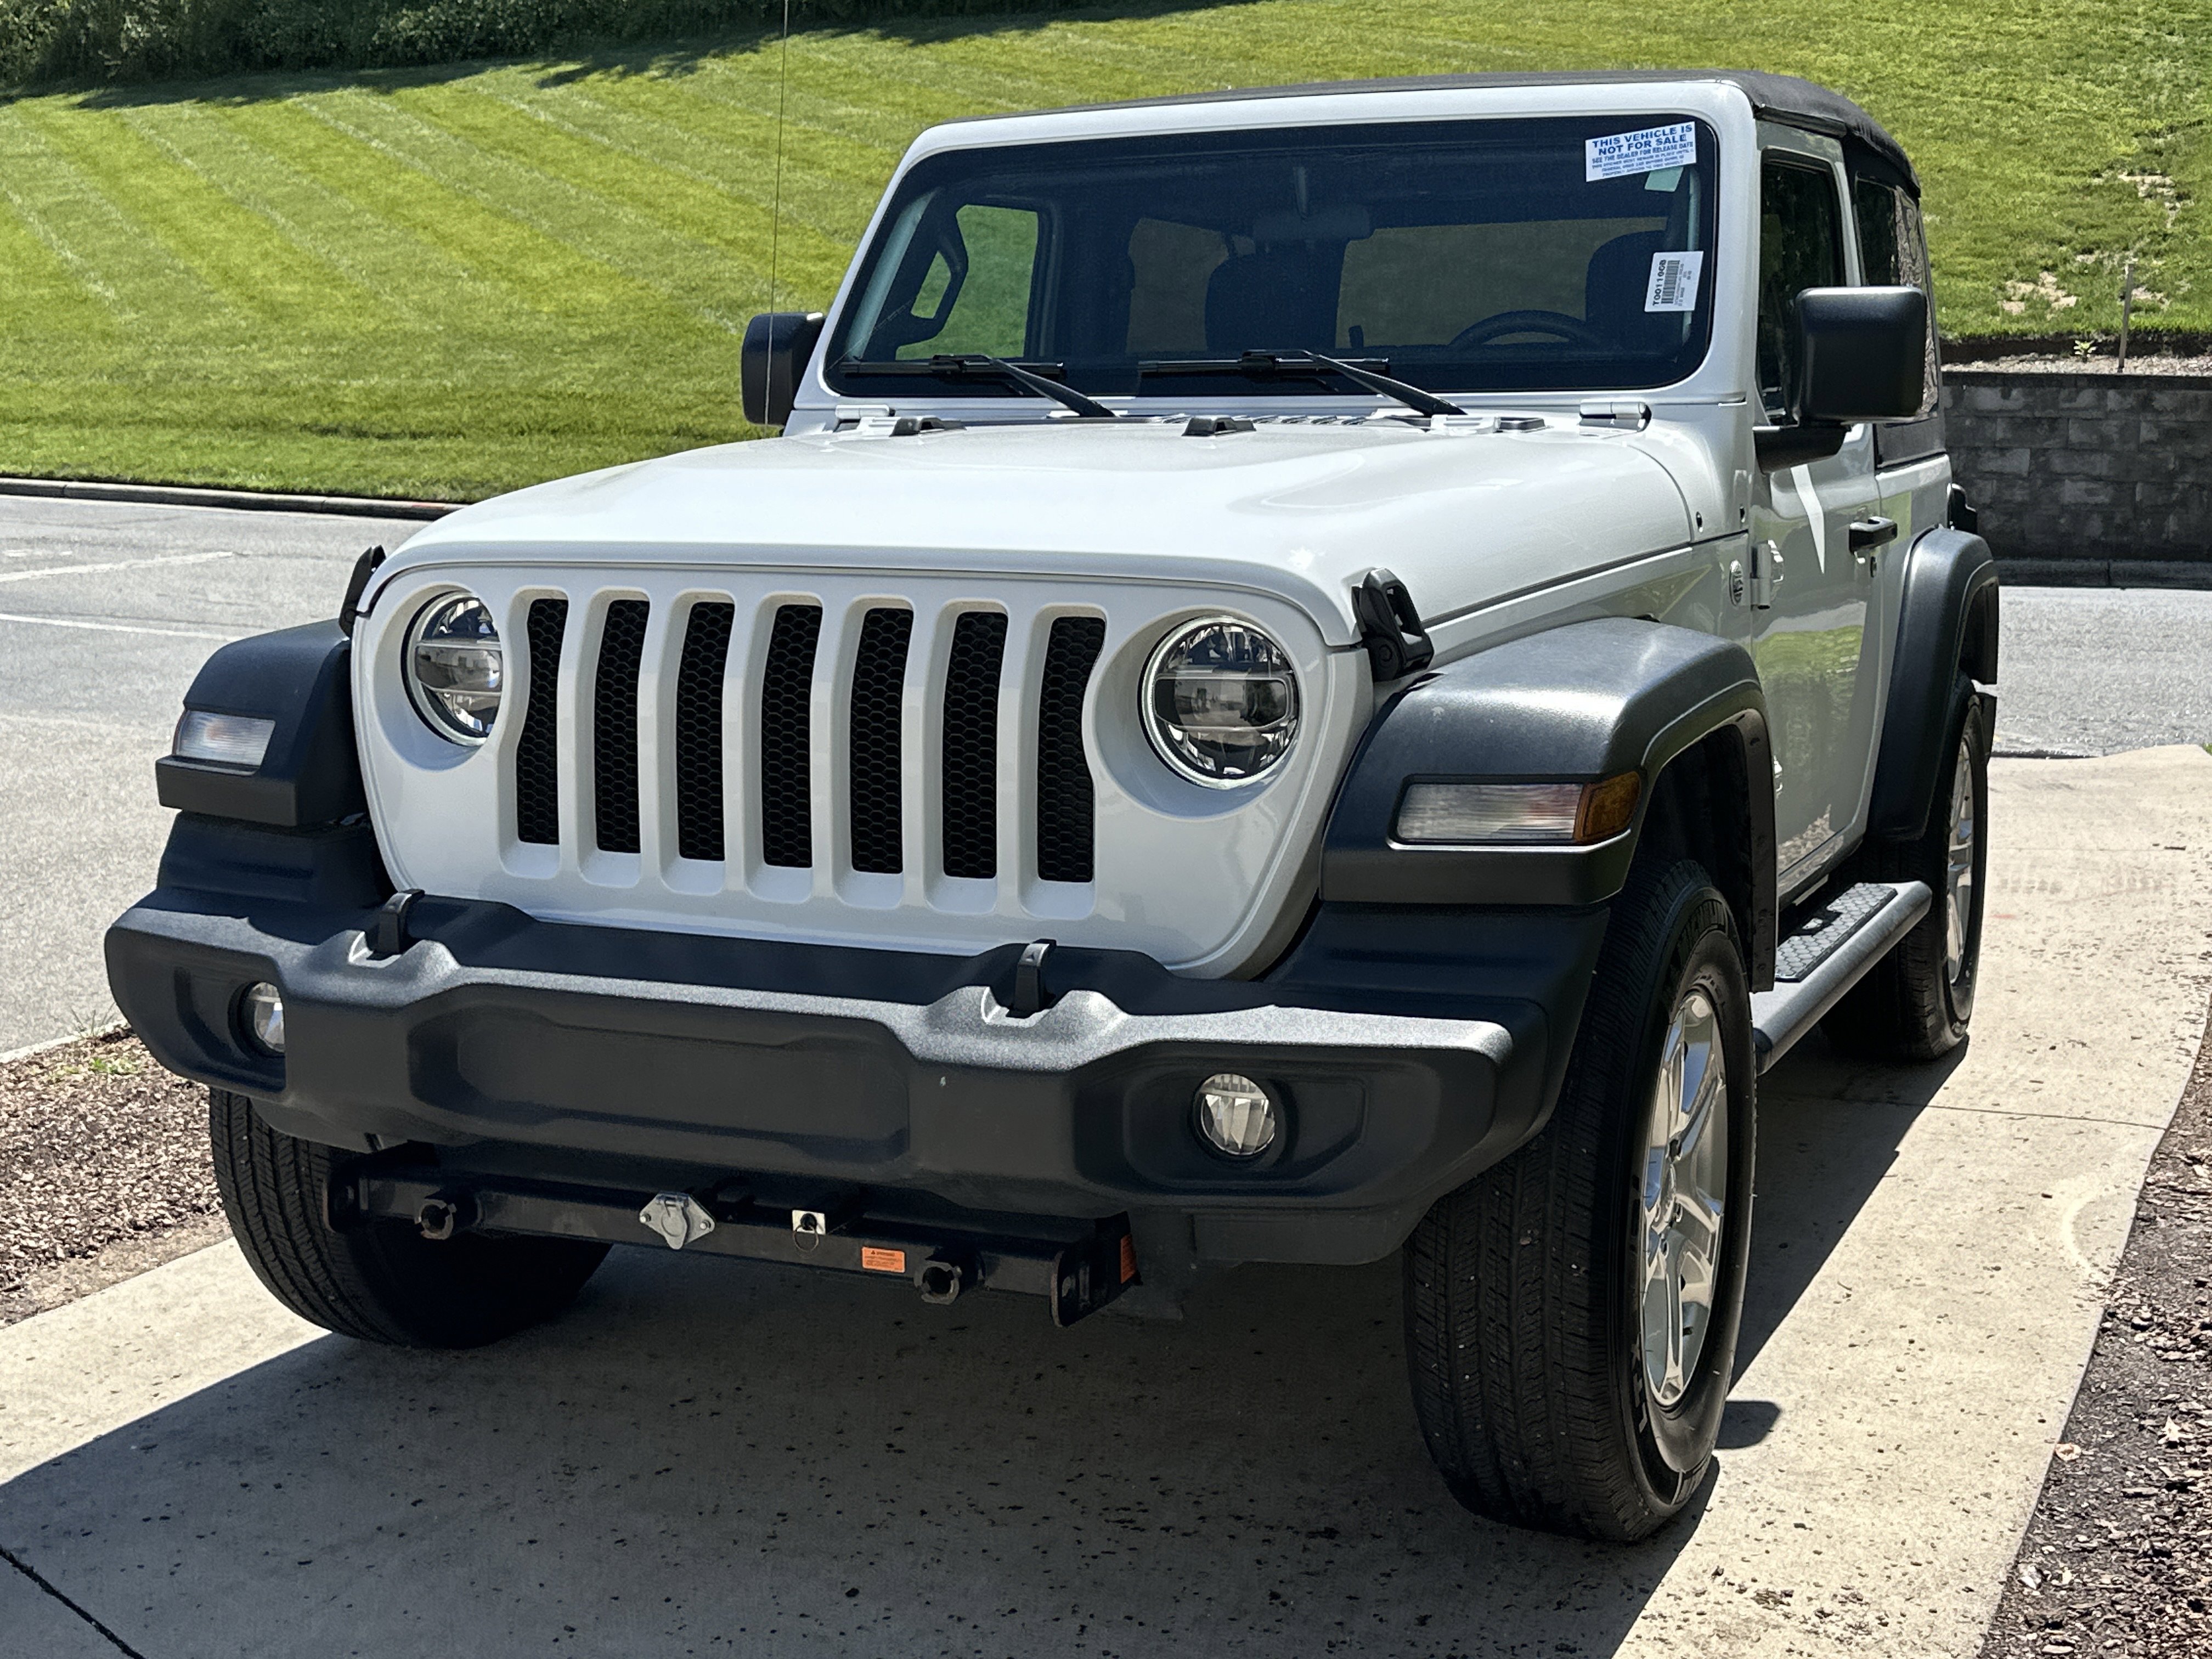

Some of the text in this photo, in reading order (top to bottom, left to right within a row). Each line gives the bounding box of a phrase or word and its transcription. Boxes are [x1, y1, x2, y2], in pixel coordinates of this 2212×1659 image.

[1592, 124, 1692, 148] THIS VEHICLE IS
[1598, 134, 1687, 156] NOT FOR SALE
